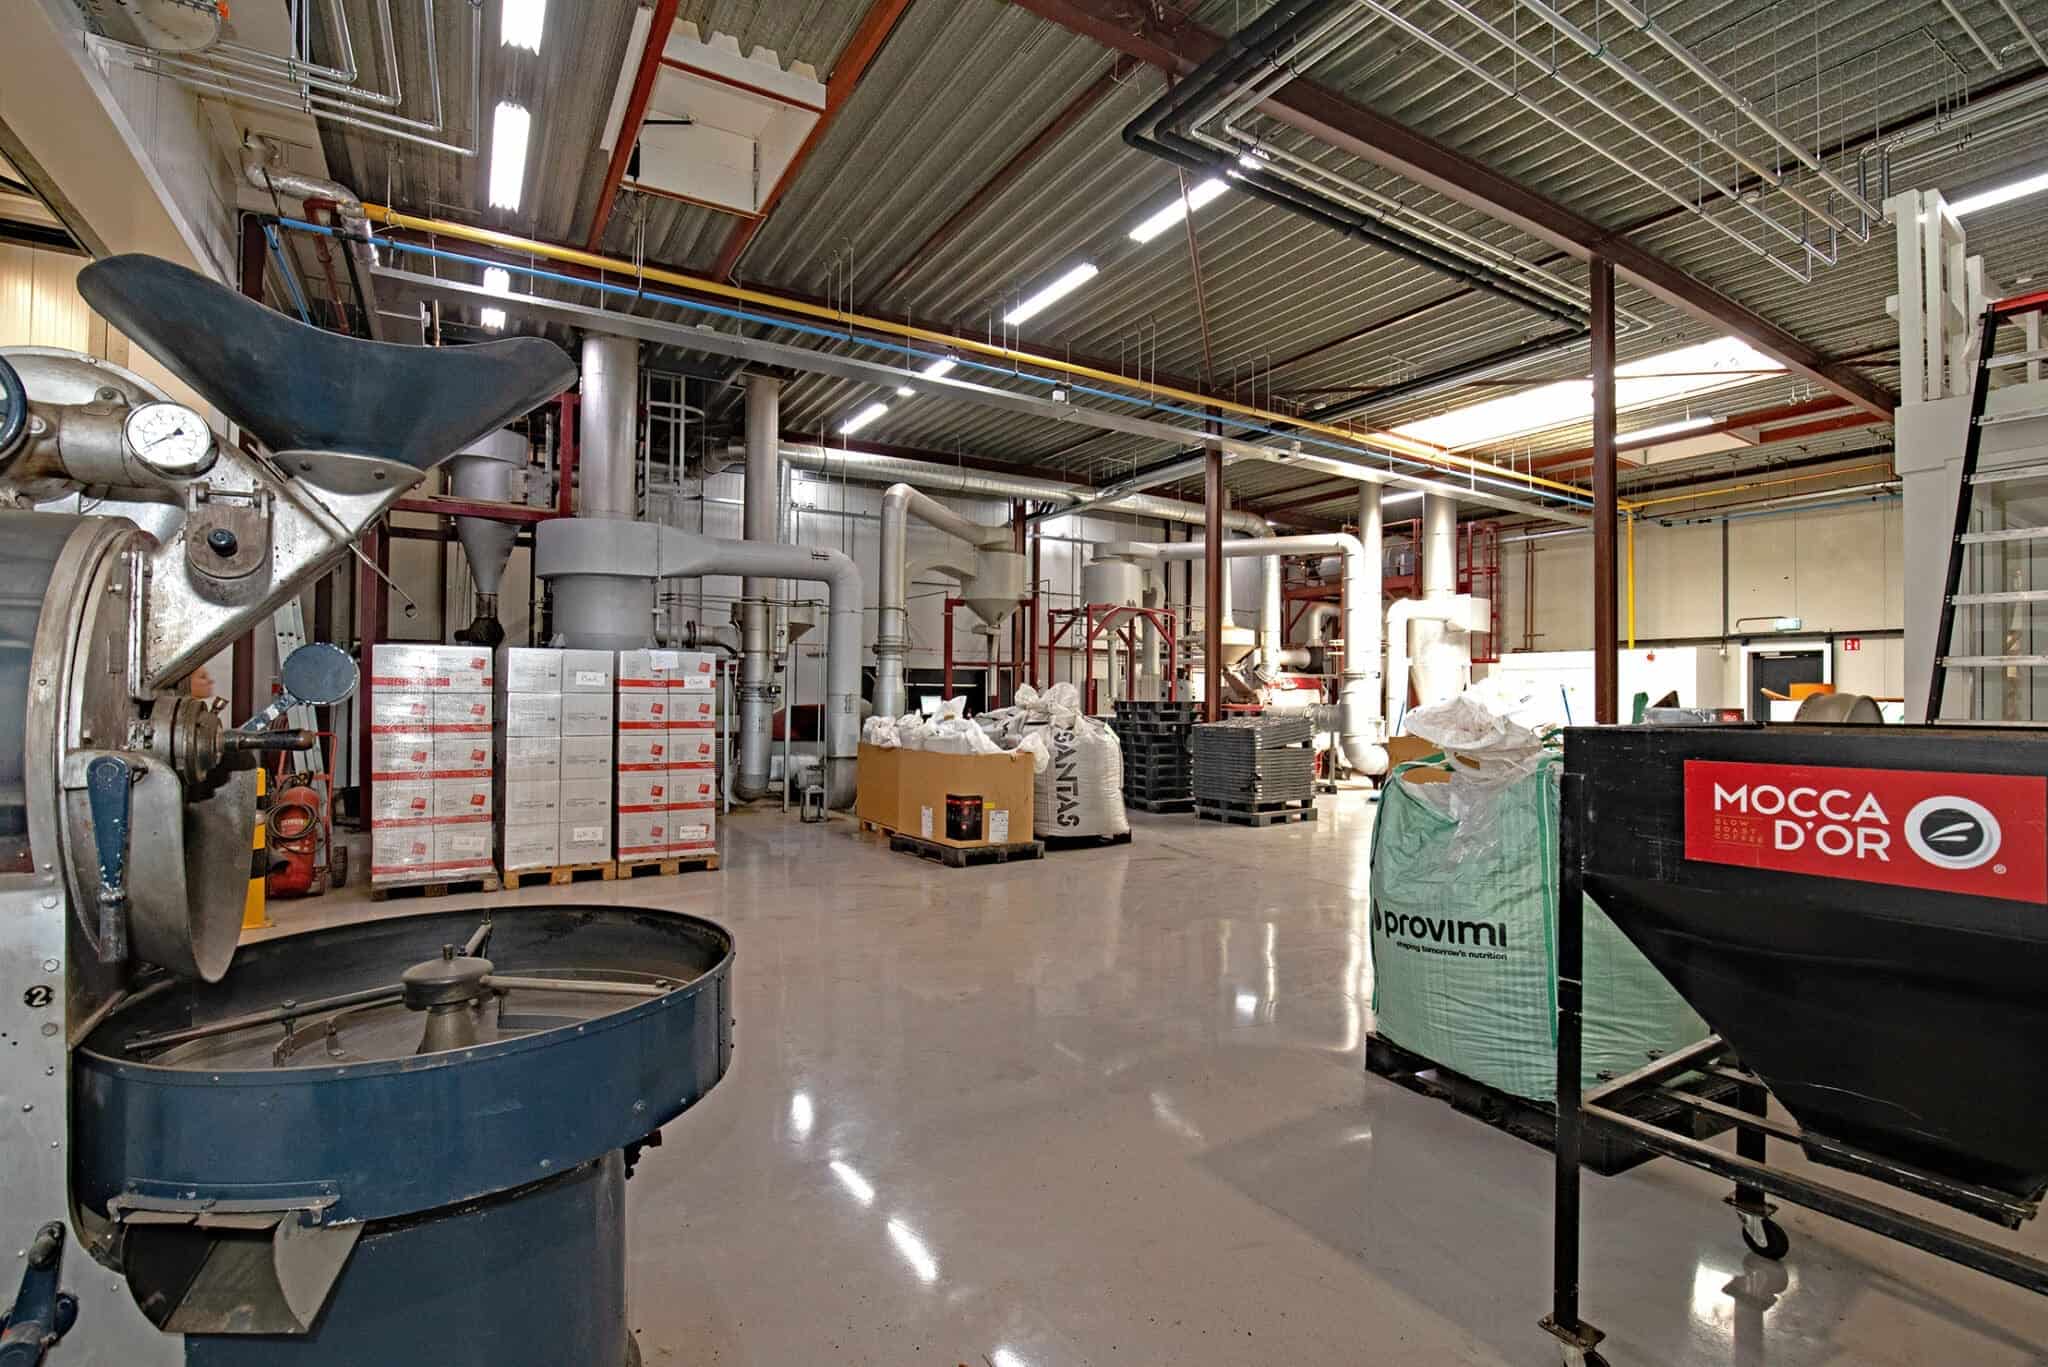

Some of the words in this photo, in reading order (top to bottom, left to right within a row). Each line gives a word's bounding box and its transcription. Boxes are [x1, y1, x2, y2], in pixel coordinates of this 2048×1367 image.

[1714, 782, 1890, 824] MOCCA
[1774, 818, 1890, 862] D'OR
[1384, 909, 1508, 947] provimi
[1468, 950, 1508, 962] nutrition
[31, 987, 47, 1005] 2
